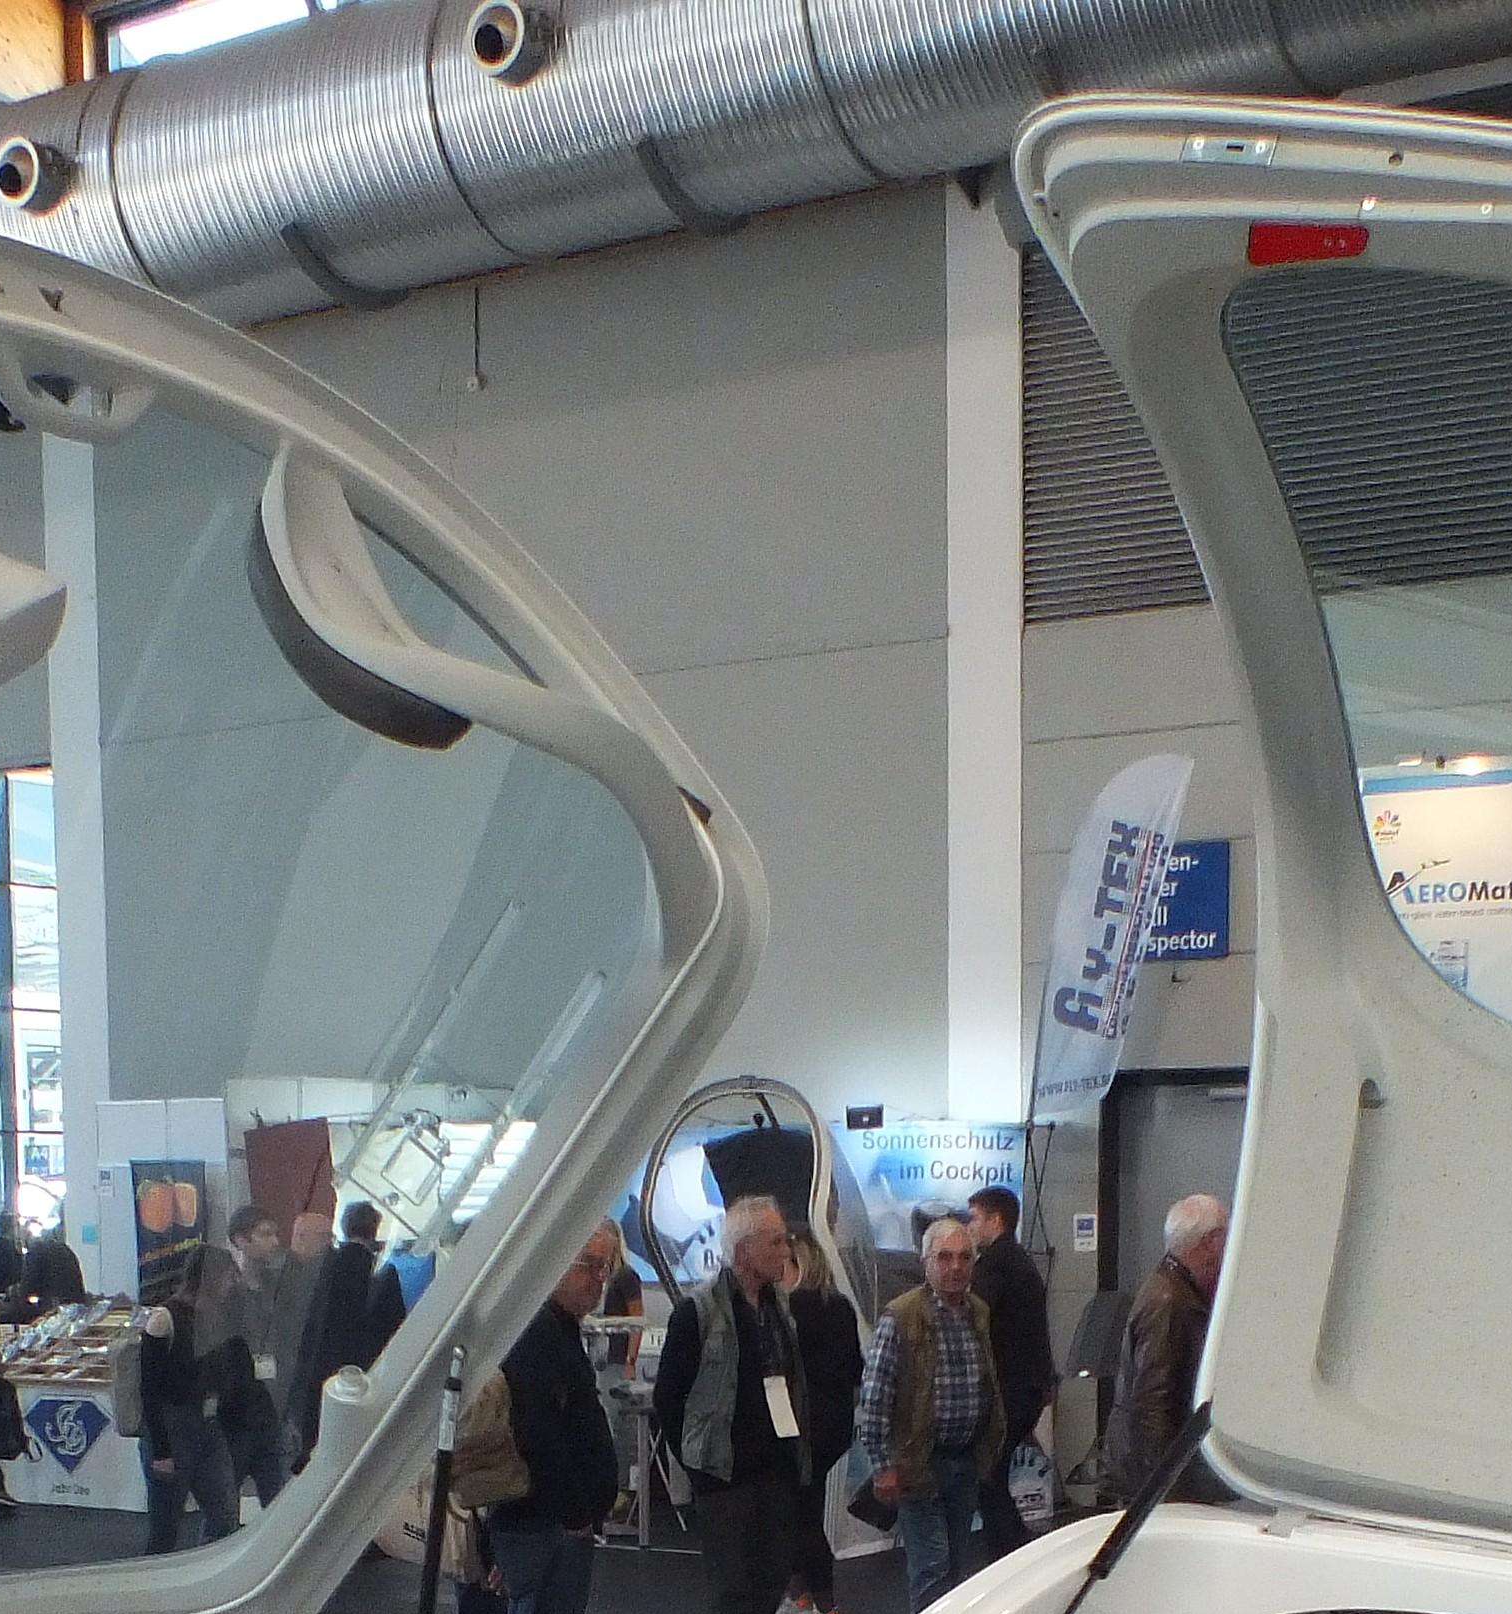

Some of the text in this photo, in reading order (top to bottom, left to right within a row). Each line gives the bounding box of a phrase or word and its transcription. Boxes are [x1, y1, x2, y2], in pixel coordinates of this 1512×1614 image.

[1168, 855, 1199, 872] en-
[1160, 880, 1178, 897] er
[1147, 929, 1217, 958] spector
[900, 1160, 1014, 1187] im Cockpit
